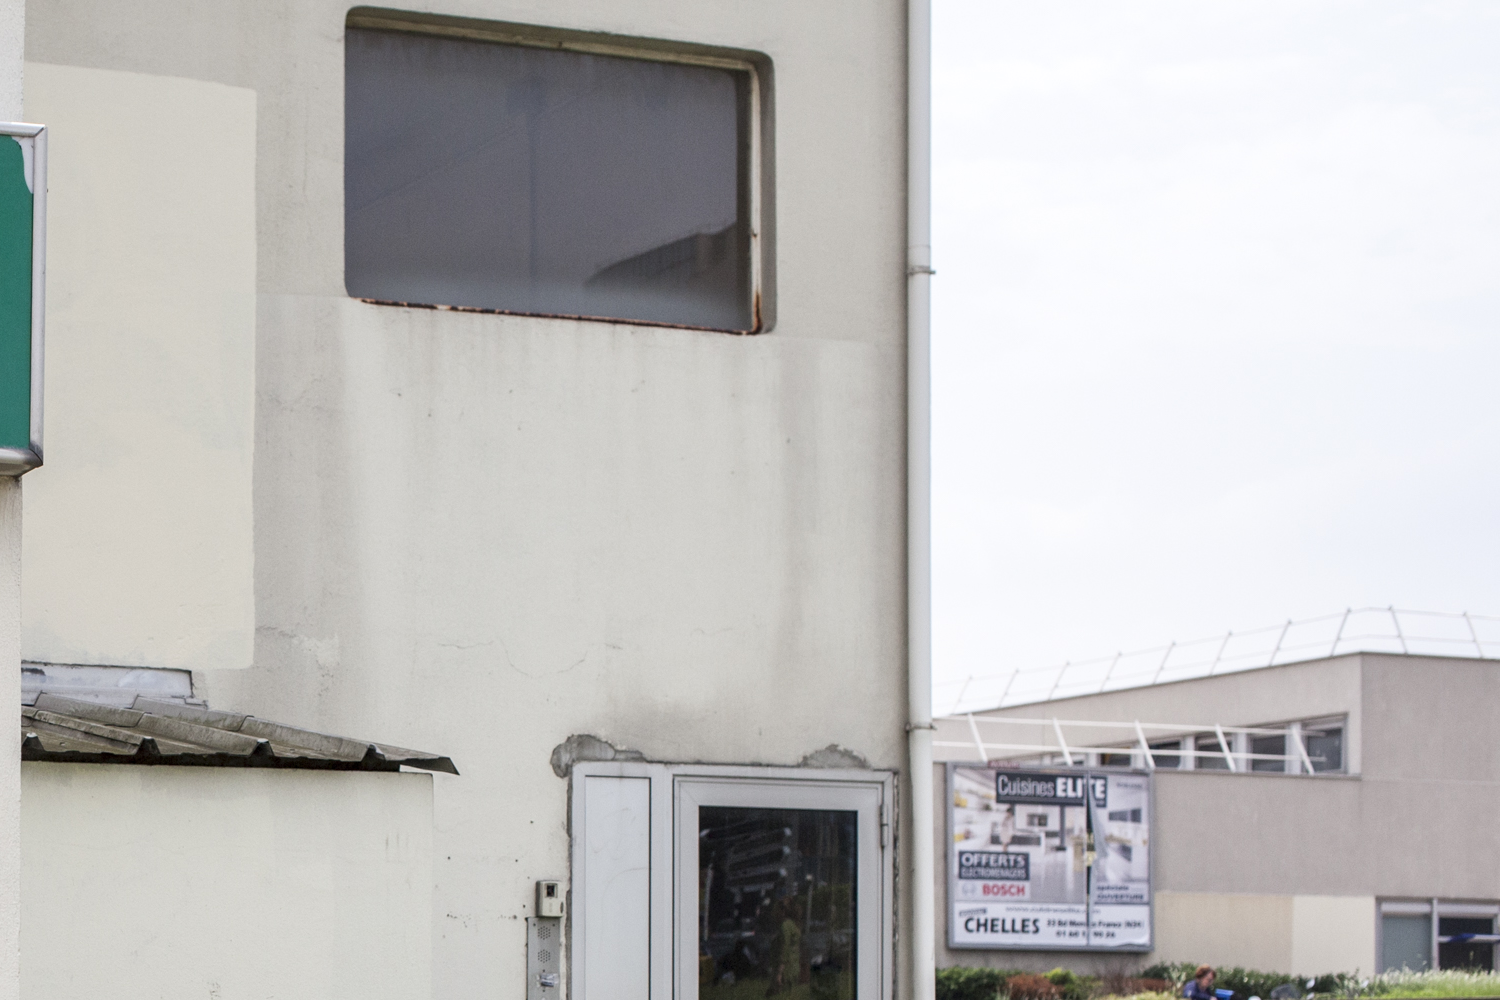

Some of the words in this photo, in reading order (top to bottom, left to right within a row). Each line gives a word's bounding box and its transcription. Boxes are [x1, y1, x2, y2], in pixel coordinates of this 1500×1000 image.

[997, 774, 1055, 798] Cuisines
[961, 853, 1026, 867] OFFERTS
[982, 883, 1025, 896] BOSCH
[964, 917, 1040, 934] CHELLES
